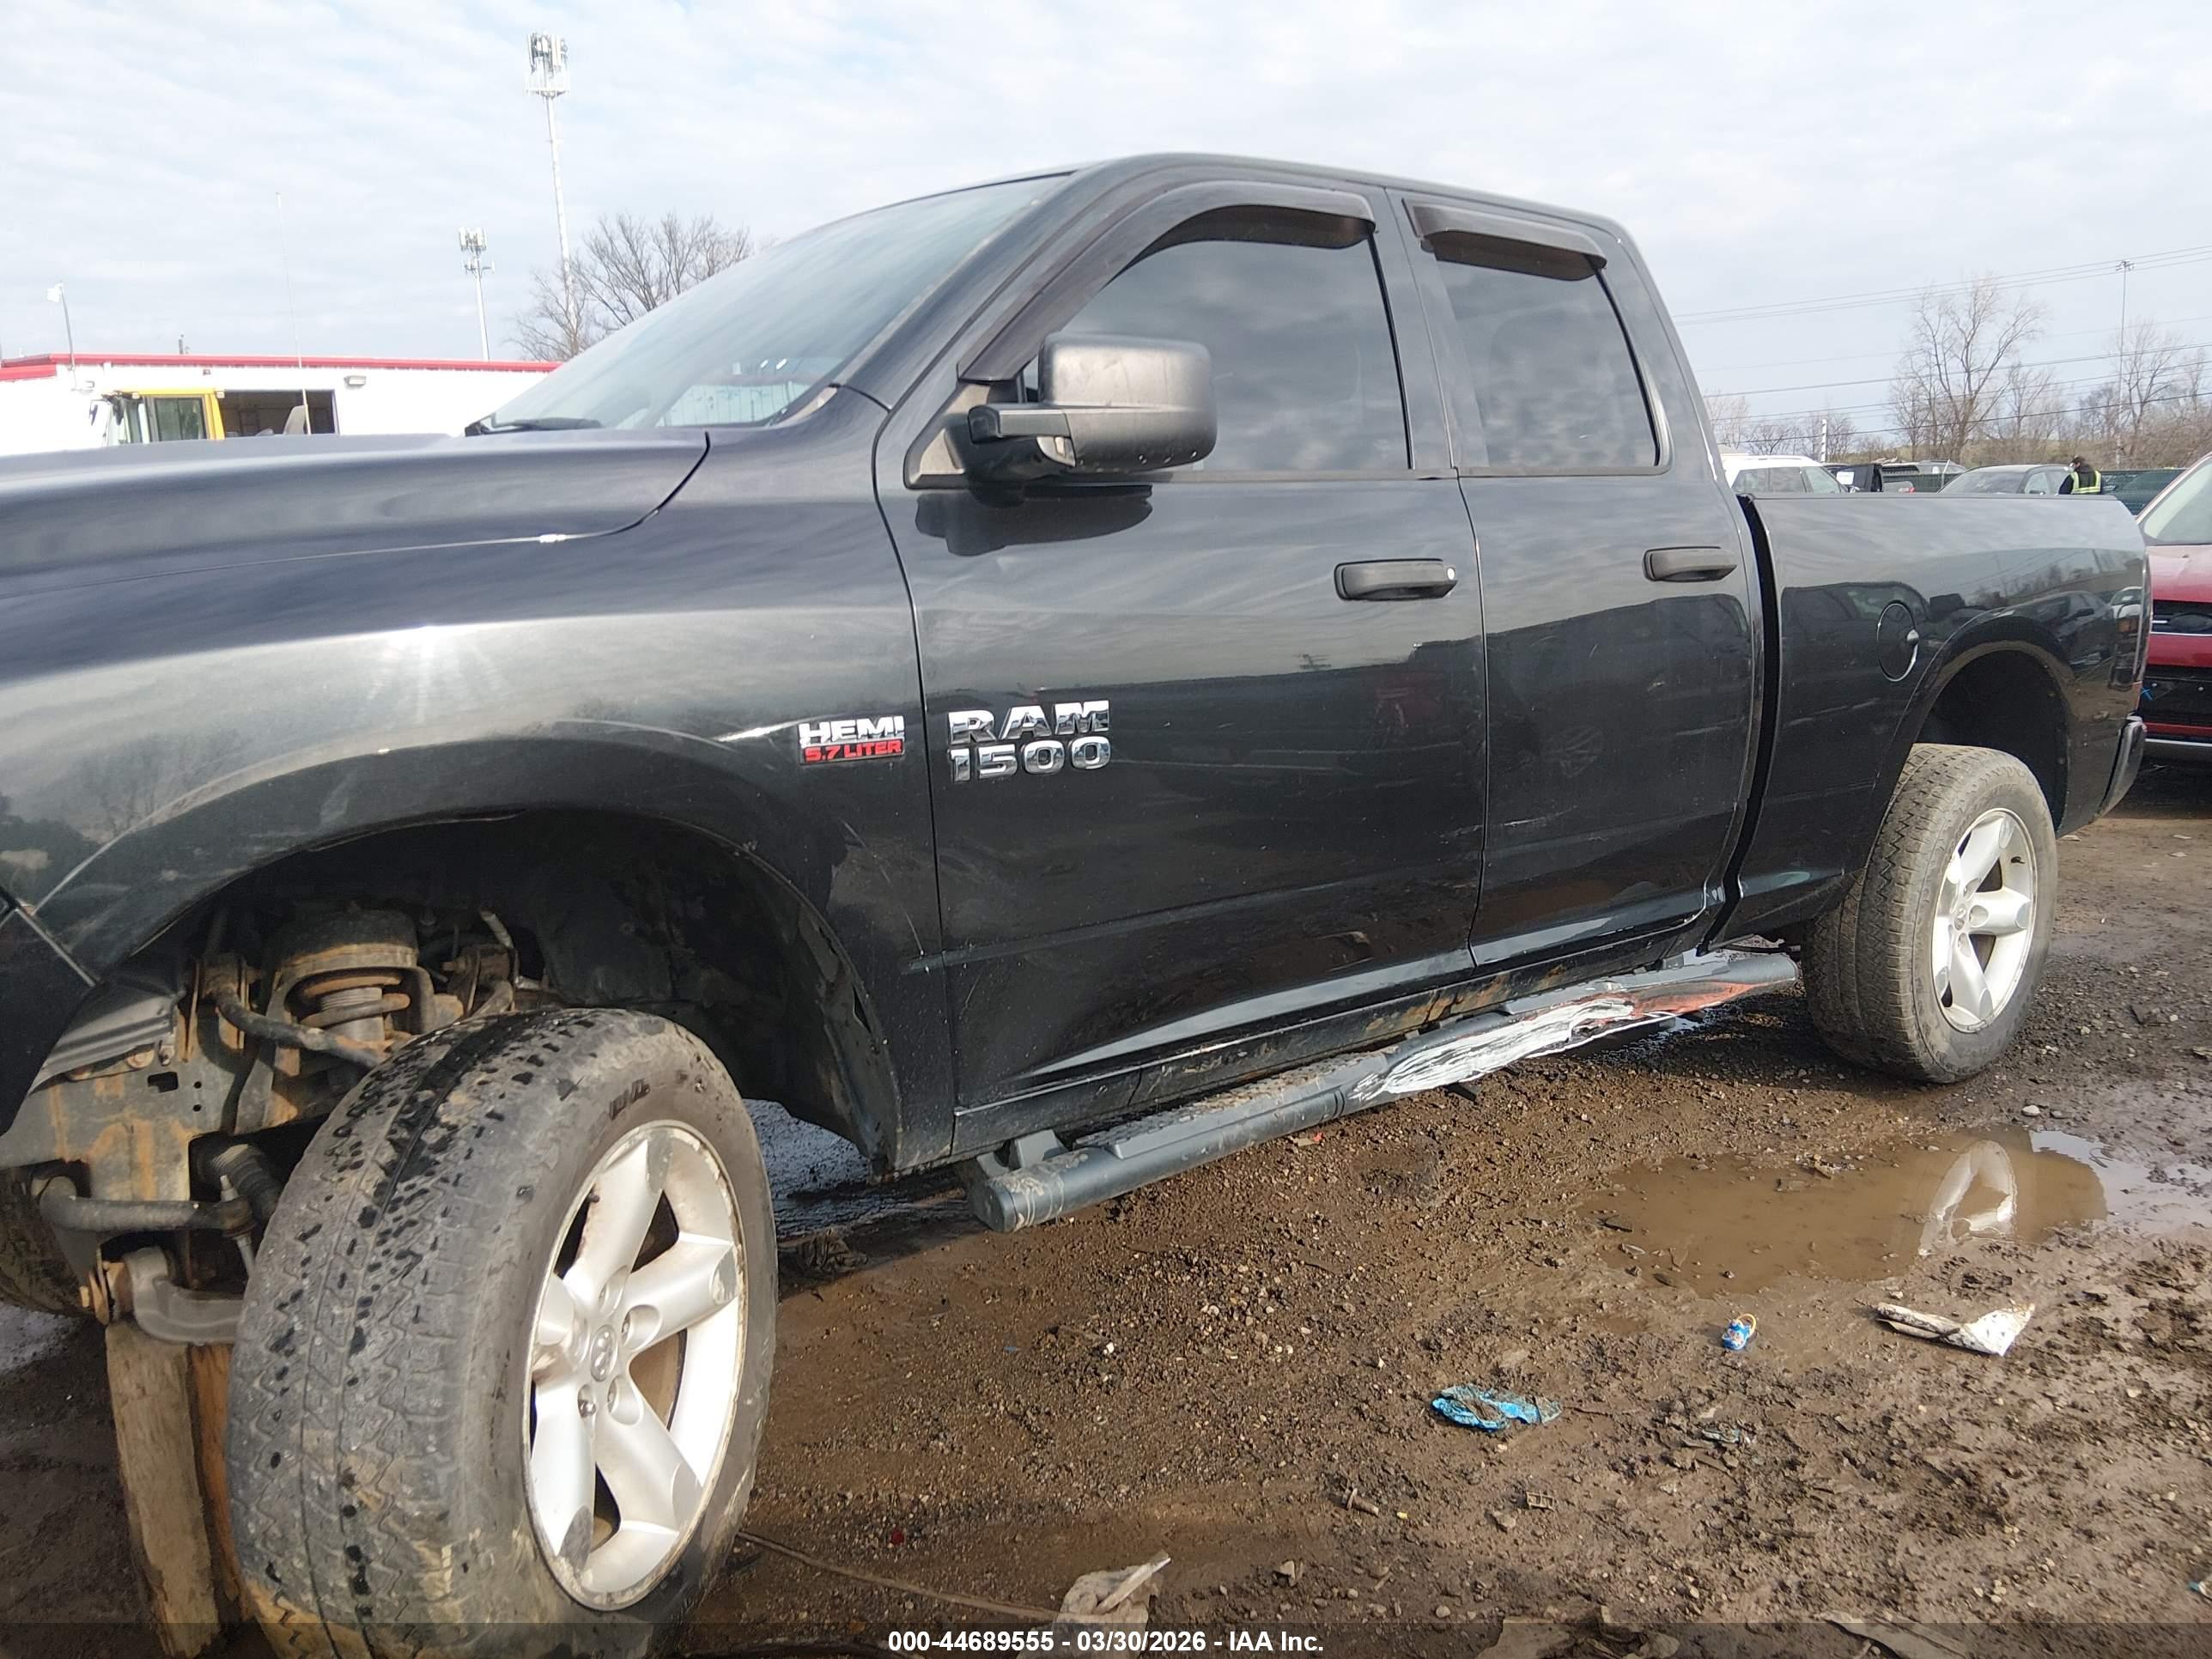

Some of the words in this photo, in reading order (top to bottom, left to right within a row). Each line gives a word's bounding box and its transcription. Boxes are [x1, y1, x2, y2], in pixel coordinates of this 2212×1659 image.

[799, 715, 905, 750] HEMI
[948, 700, 1109, 744] RAM
[805, 745, 842, 763] 5.7
[843, 739, 902, 759] LITER
[947, 735, 1110, 782] 1500
